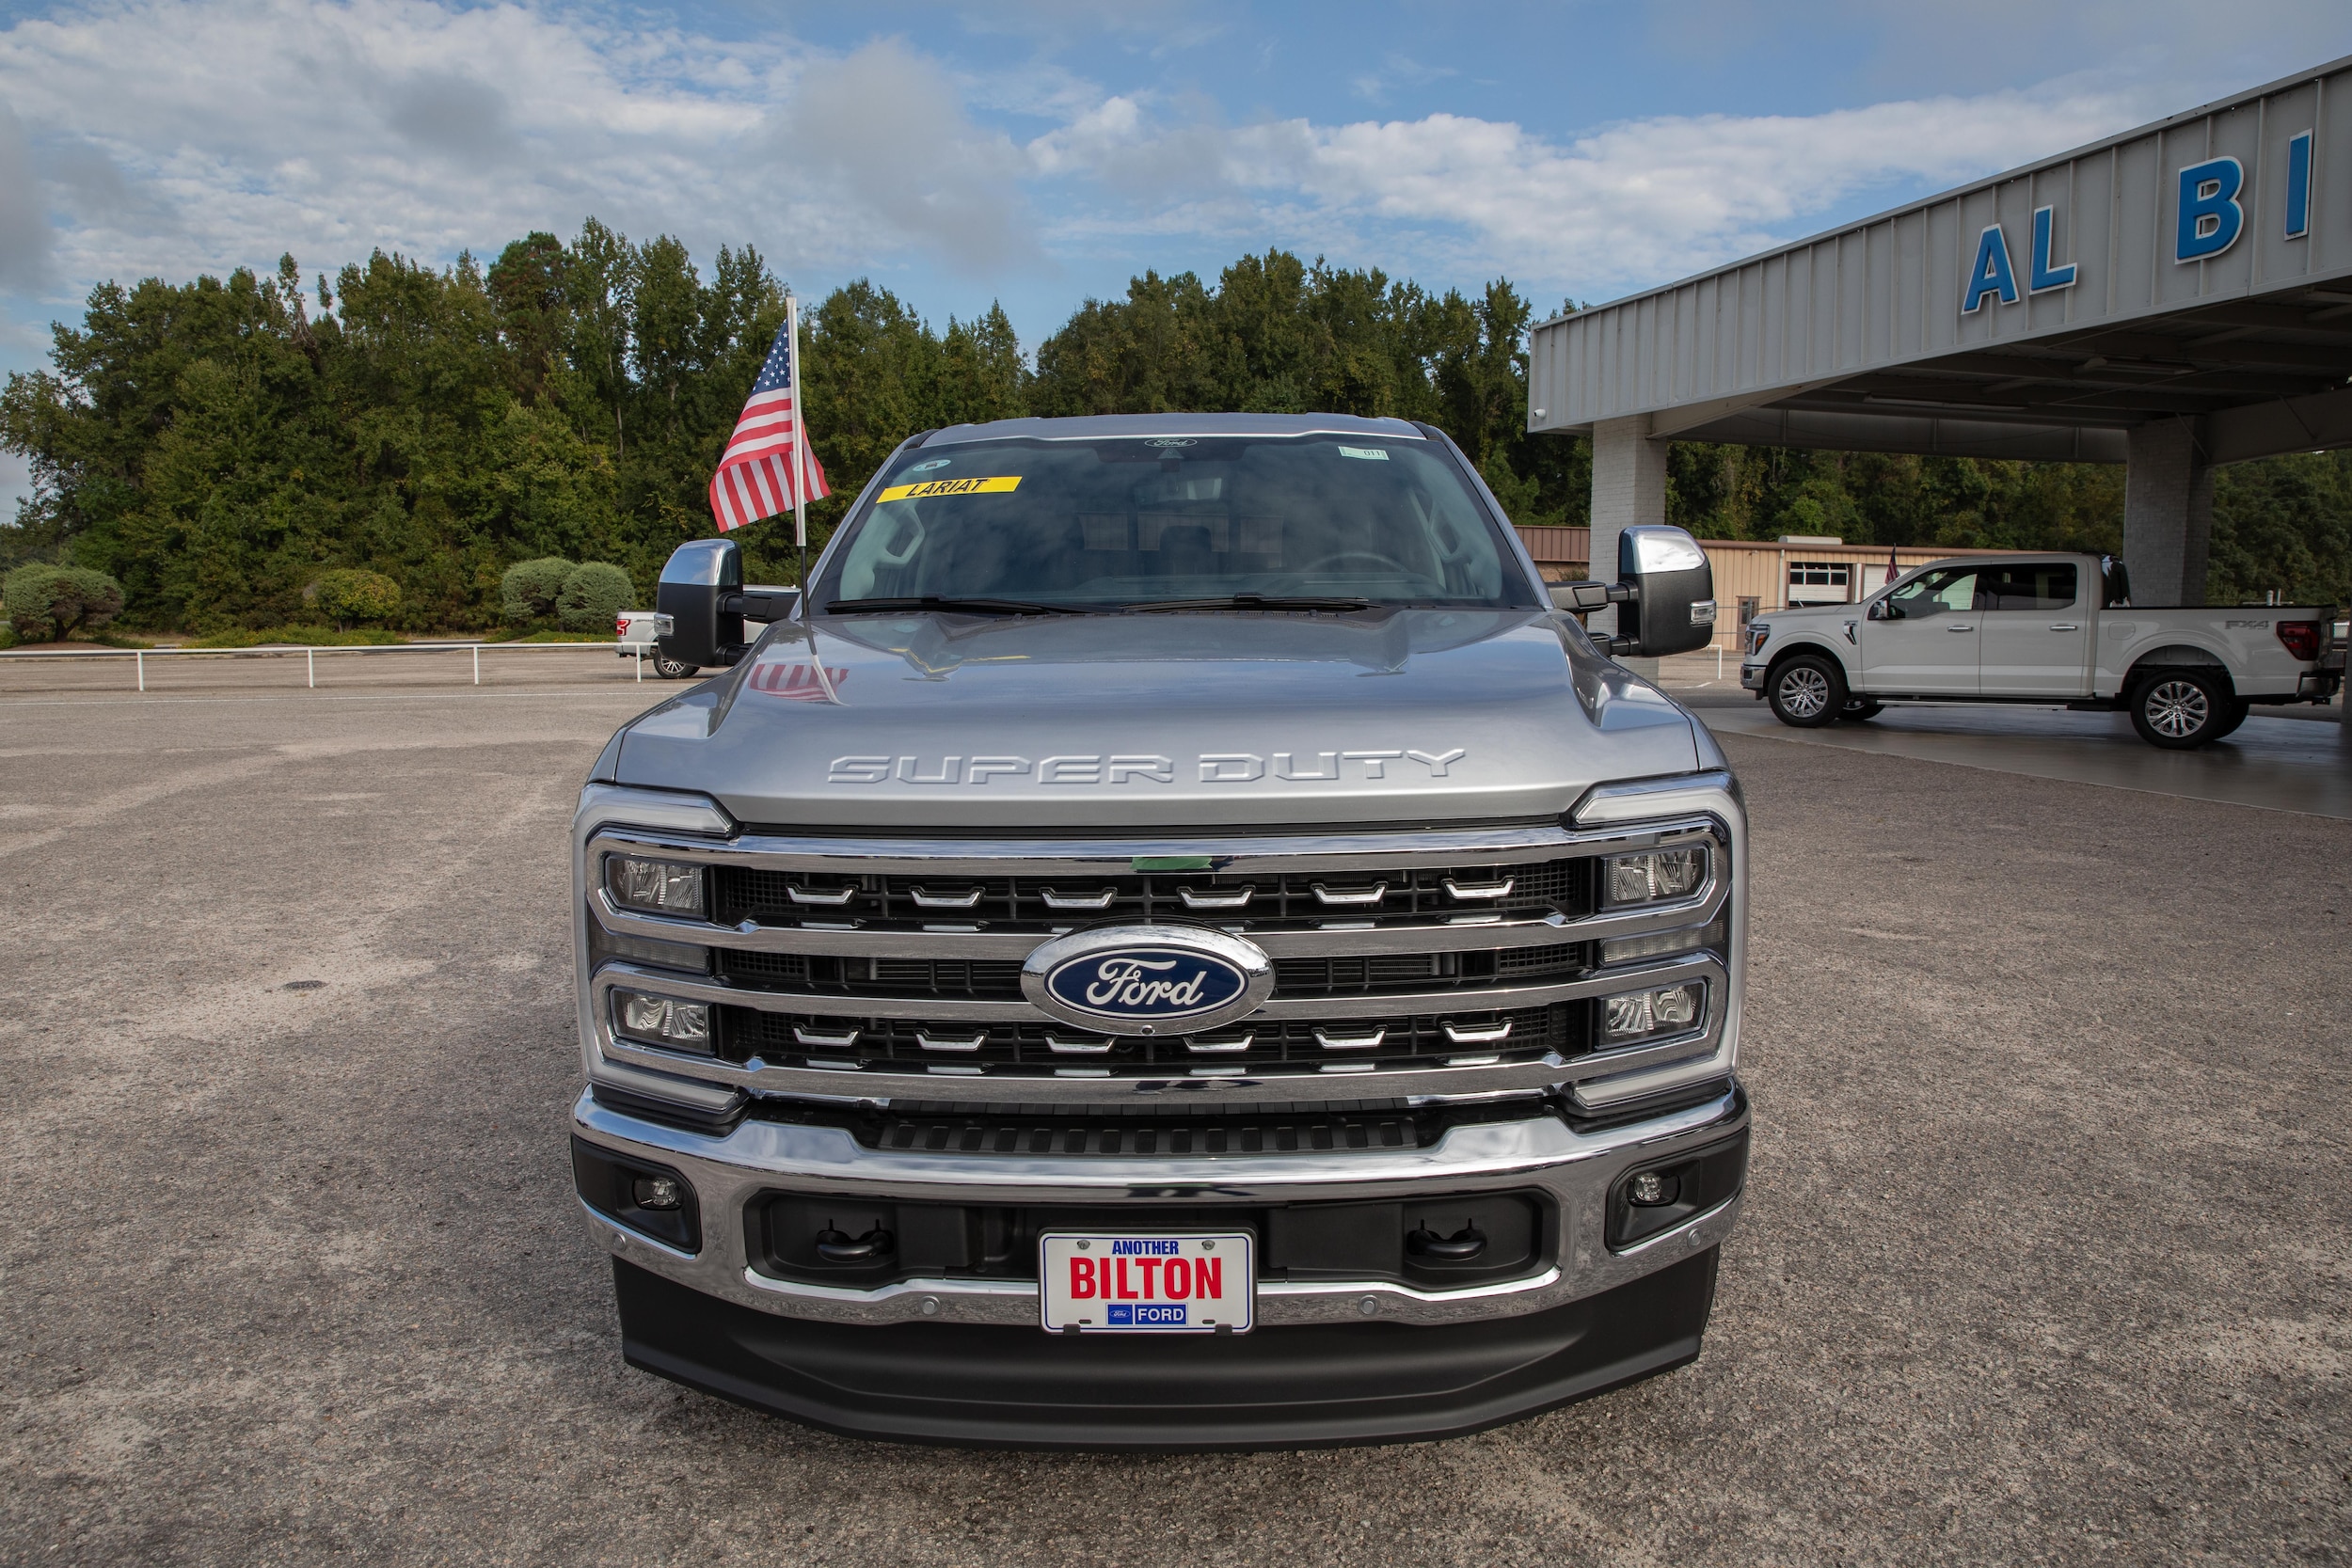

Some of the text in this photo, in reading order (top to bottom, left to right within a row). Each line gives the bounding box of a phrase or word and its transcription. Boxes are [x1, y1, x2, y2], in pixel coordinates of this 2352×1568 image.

[1960, 204, 2077, 314] AL
[905, 478, 989, 498] LARIAT
[2225, 620, 2269, 629] FX4
[827, 748, 1468, 784] SUPER DUTY
[1086, 958, 1207, 1006] Ford
[1112, 1240, 1179, 1255] ANOTHER
[1070, 1257, 1222, 1300] BILTON
[1137, 1308, 1184, 1322] FORD
